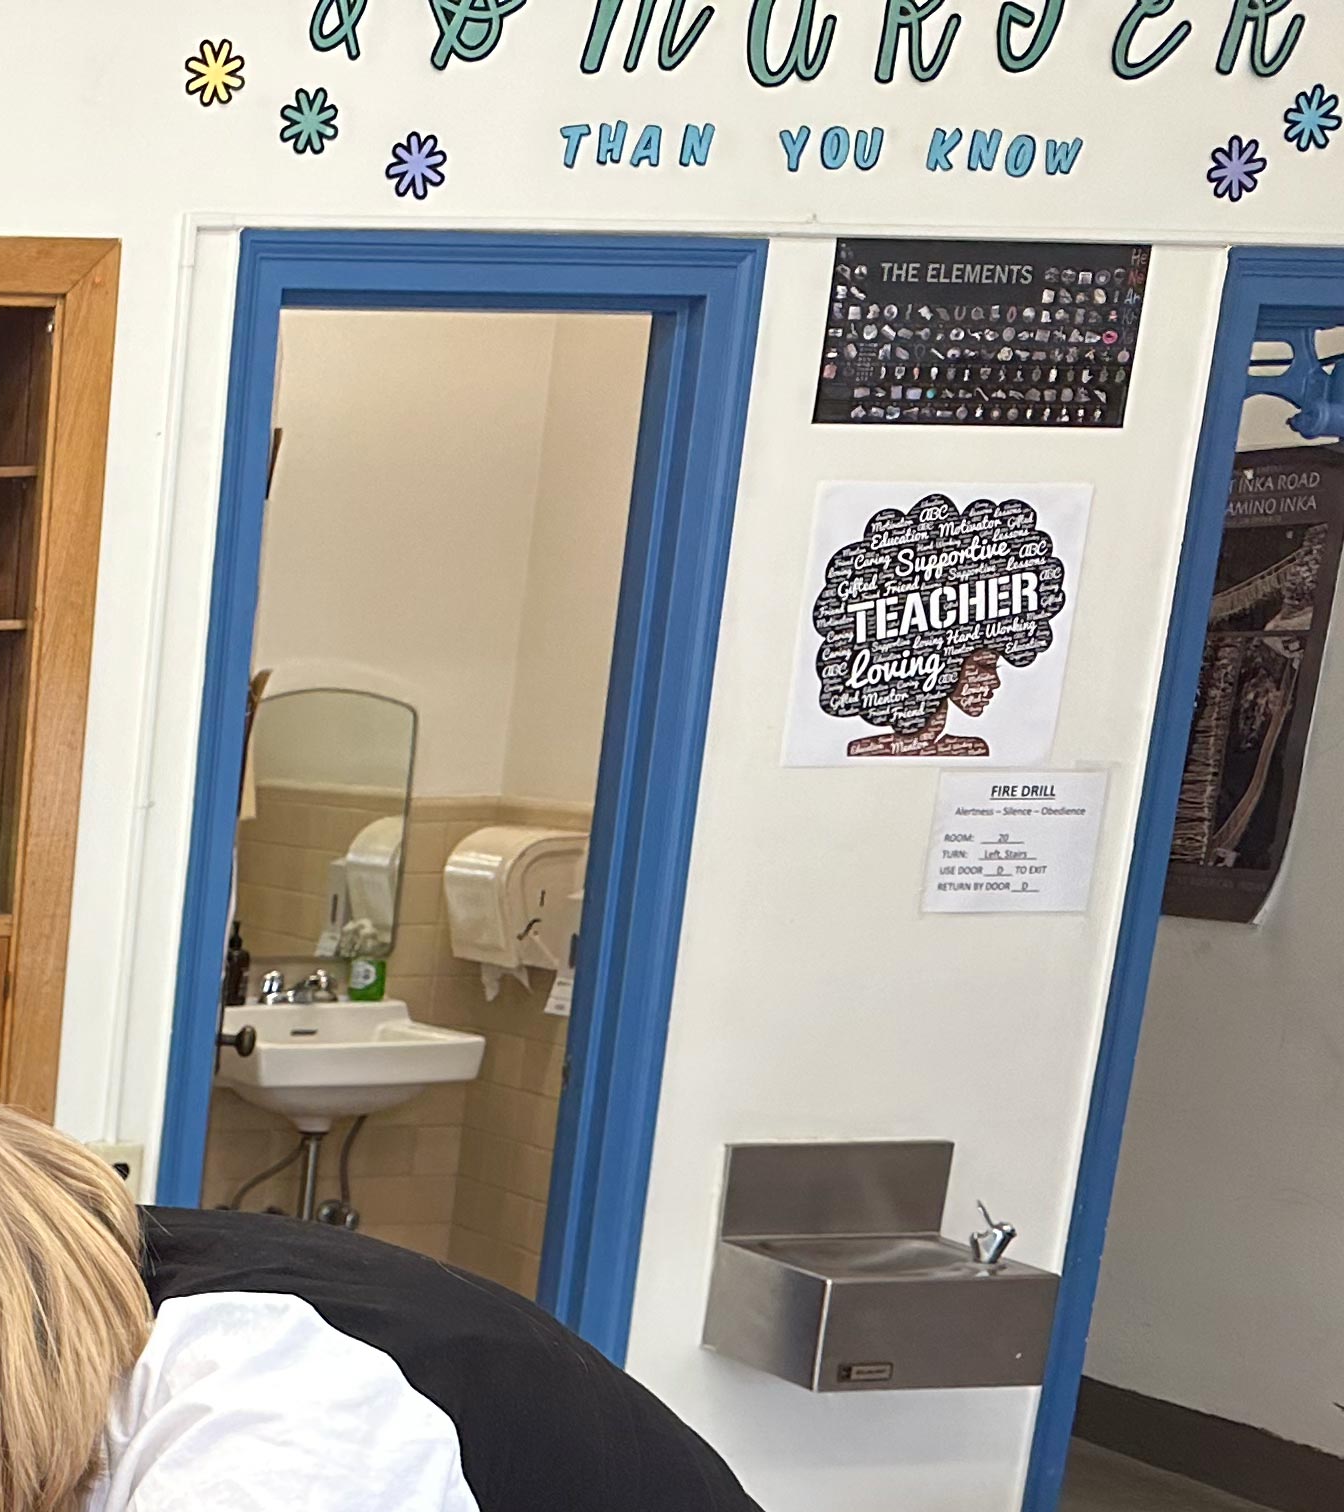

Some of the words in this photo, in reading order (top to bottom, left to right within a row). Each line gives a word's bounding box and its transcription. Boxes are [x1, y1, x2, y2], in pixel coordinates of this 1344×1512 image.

[560, 119, 716, 169] THAN
[779, 125, 885, 172] YOU
[924, 126, 1085, 179] KNOW
[881, 262, 921, 283] THE
[927, 262, 1033, 285] ELEMENTS
[1238, 475, 1274, 494] INKA
[1277, 471, 1320, 491] ROAD
[919, 504, 949, 522] ABC
[1279, 495, 1317, 513] INKA
[938, 515, 1003, 538] Motivator
[870, 528, 929, 550] Education
[854, 553, 892, 570] Caring
[895, 535, 1011, 581] Supportive
[837, 573, 878, 600] Gifted
[883, 575, 920, 596] Friend
[847, 571, 1038, 644] TEACHER
[845, 648, 946, 692] Loving
[861, 688, 909, 709] Mentor
[990, 785, 1018, 798] FIRE
[1021, 784, 1056, 797] DRILL
[1003, 807, 1033, 816] Silence
[1041, 807, 1086, 816] Obedience
[944, 834, 975, 843] ROOM:
[997, 833, 1009, 843] 20
[942, 850, 968, 859] TURN:
[1004, 850, 1028, 860] Stairs
[939, 866, 955, 875] USE
[957, 866, 983, 875] DOOR
[1015, 865, 1027, 875] TO
[937, 882, 971, 891] RETURN
[973, 882, 984, 891] BY
[985, 882, 1011, 891] DOOR
